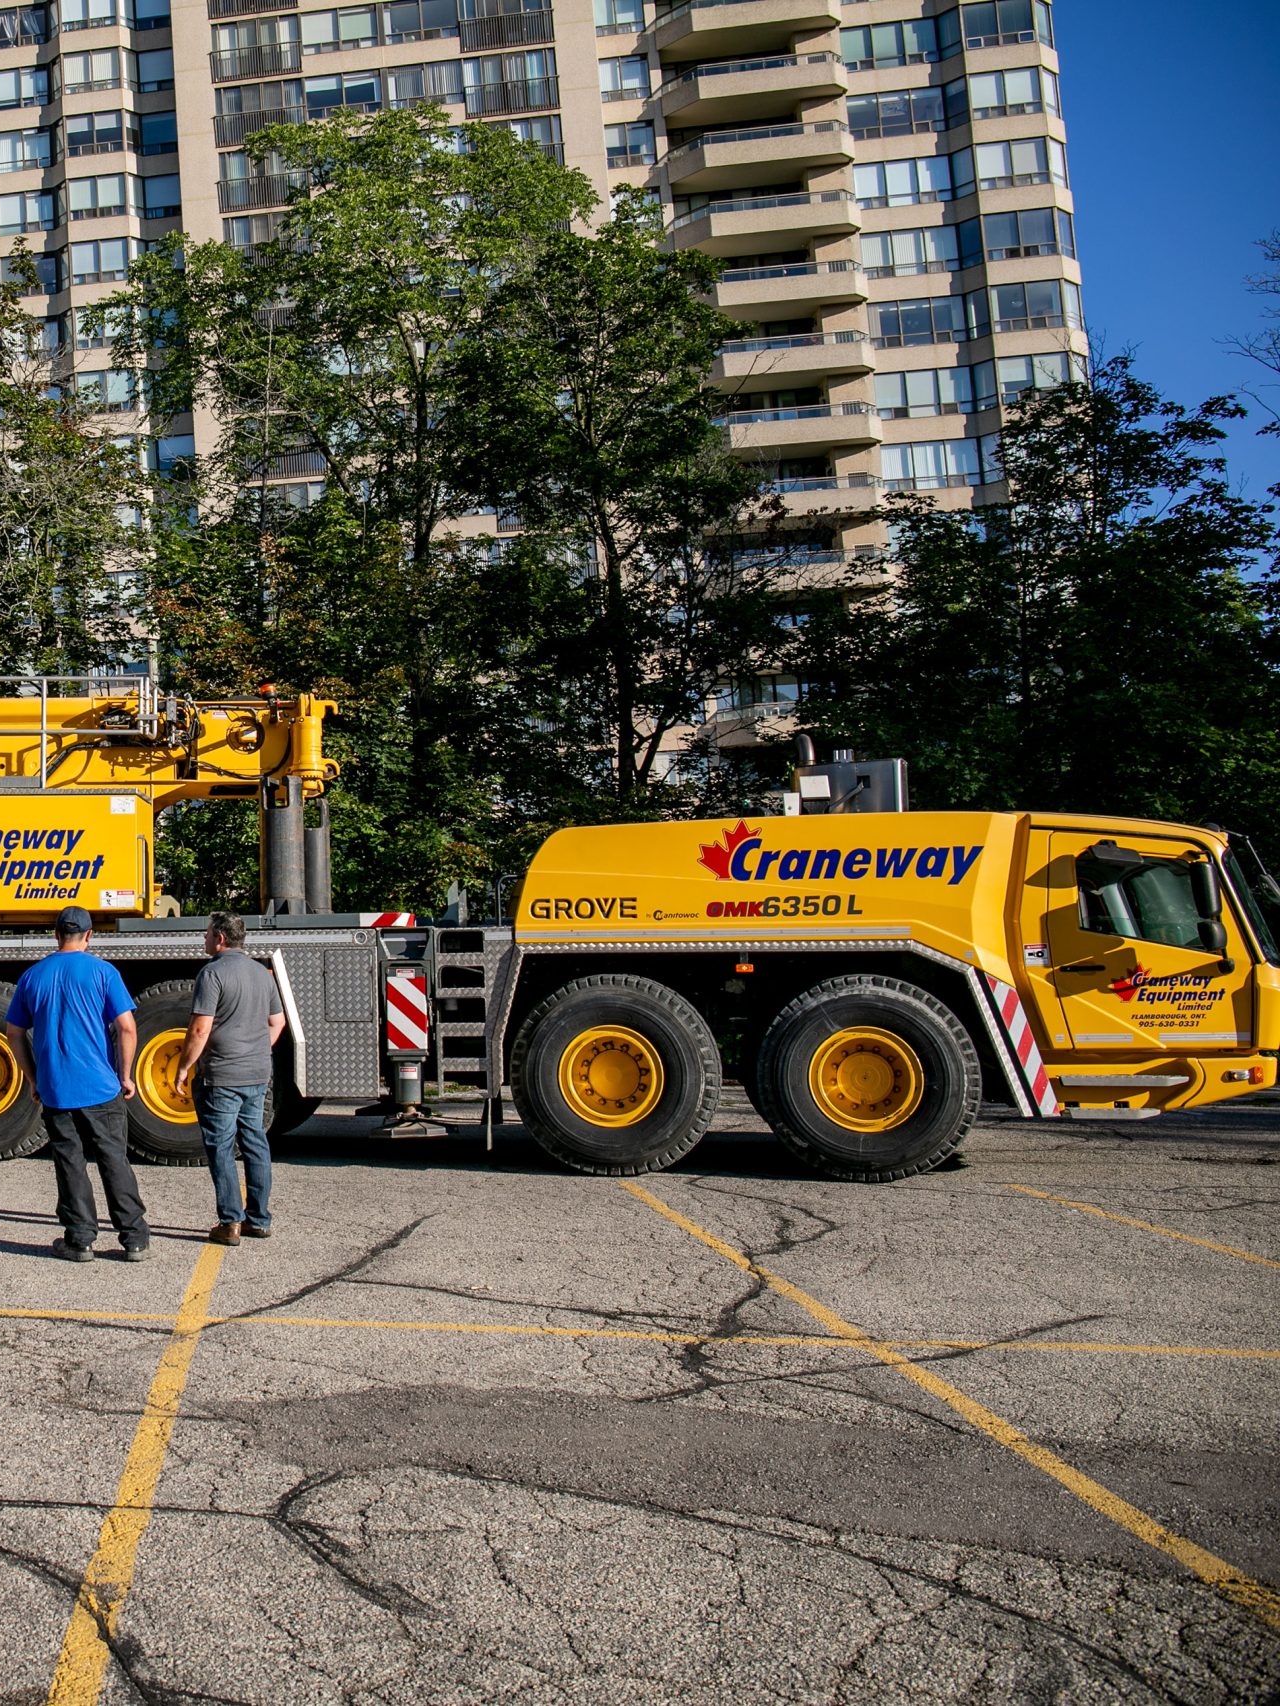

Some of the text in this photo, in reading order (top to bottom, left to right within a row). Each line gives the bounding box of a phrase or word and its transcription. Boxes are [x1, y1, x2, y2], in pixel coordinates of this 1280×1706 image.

[730, 838, 984, 885] Craneway
[15, 883, 80, 898] Limited
[529, 897, 638, 920] GROVE
[653, 909, 700, 921] Manitowoc
[1132, 972, 1214, 988] Craneway
[1137, 987, 1225, 1004] Equipment
[1177, 1002, 1213, 1011] Limited
[1138, 1020, 1199, 1028] 905-630-0331
